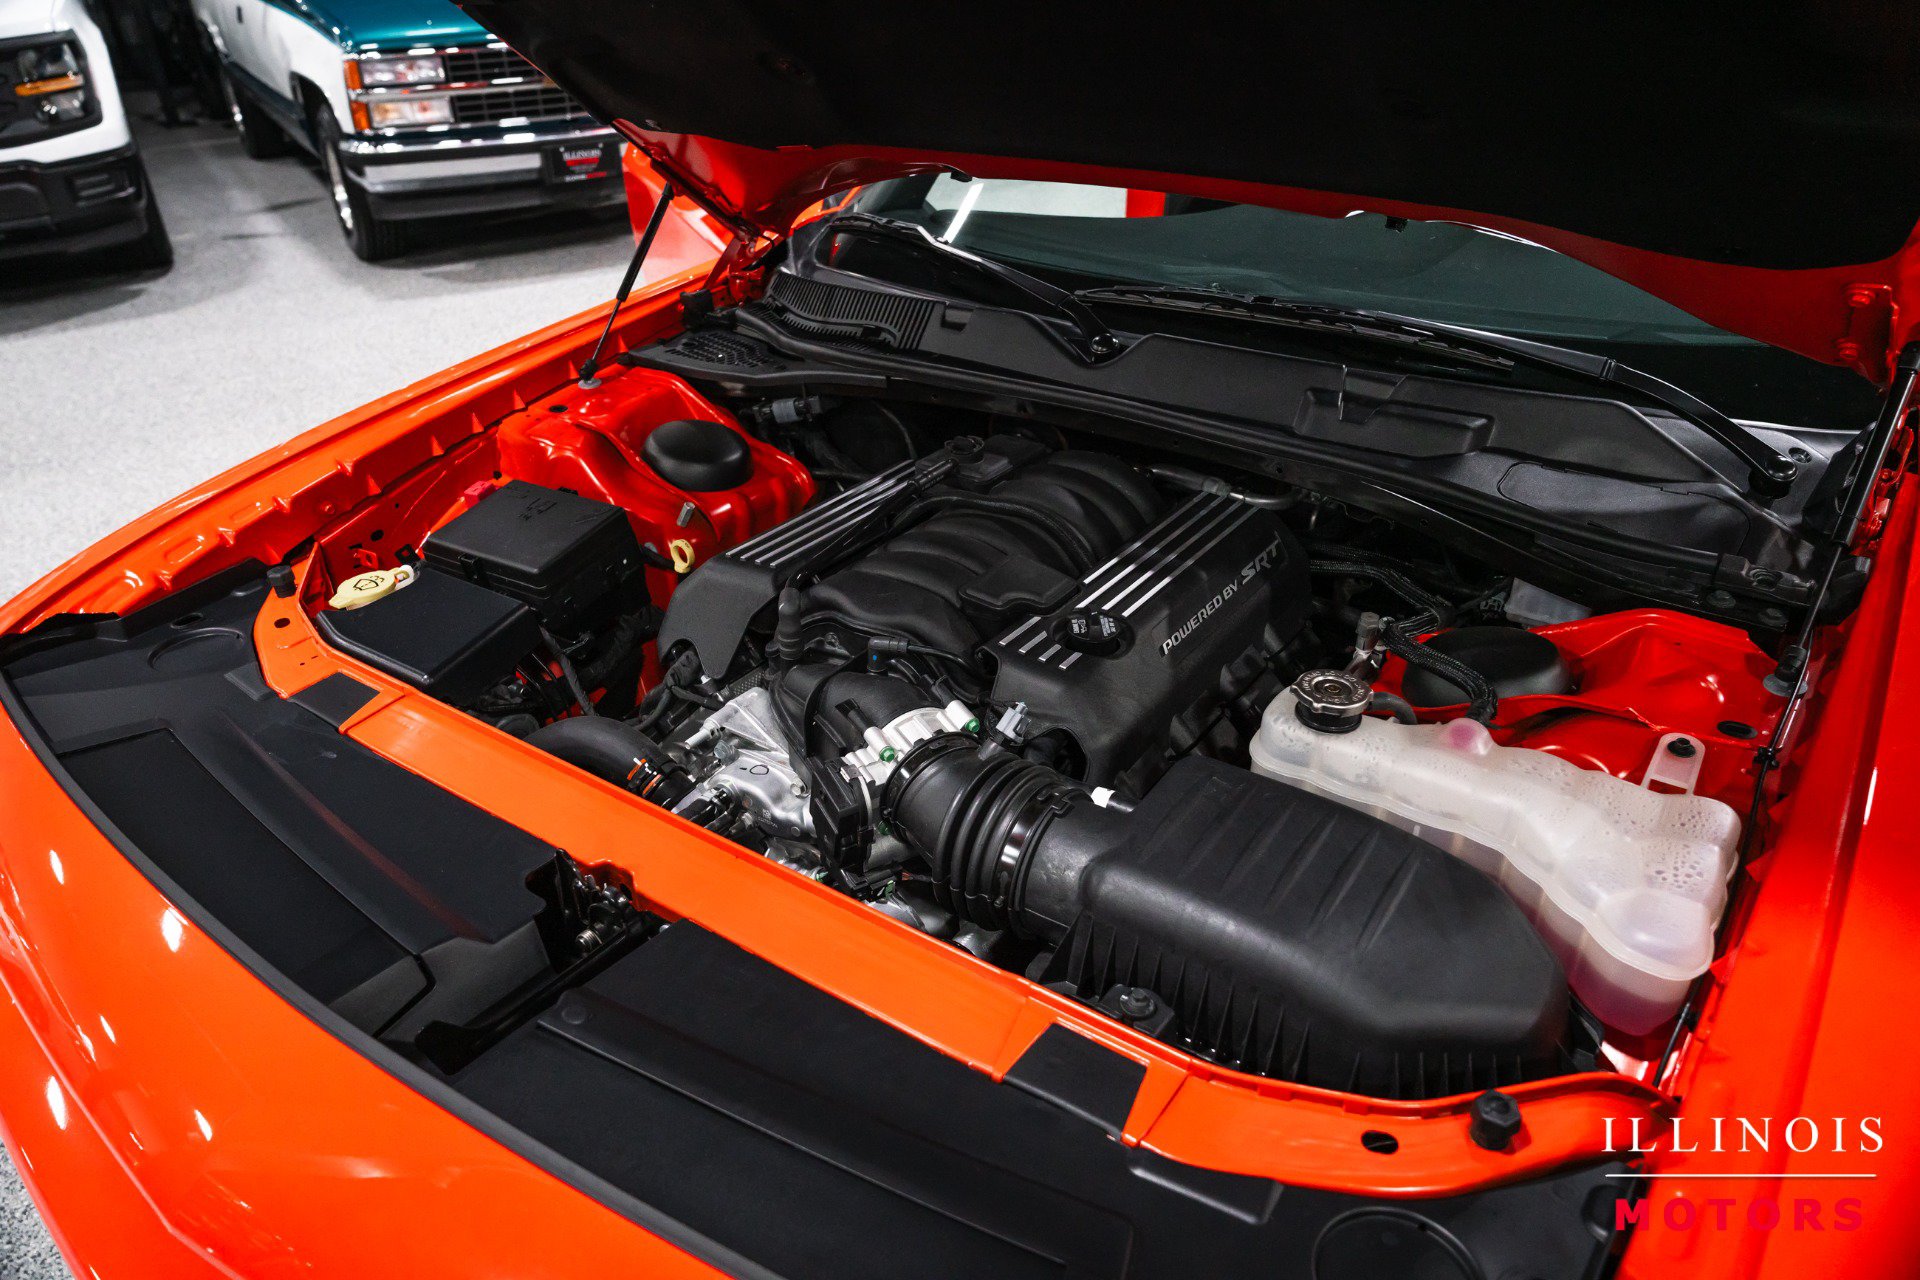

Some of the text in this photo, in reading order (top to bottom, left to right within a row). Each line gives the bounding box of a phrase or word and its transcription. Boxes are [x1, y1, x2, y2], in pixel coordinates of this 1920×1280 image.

[1162, 595, 1223, 655] POWERED
[1222, 579, 1238, 600] BY
[1241, 539, 1280, 585] SRT
